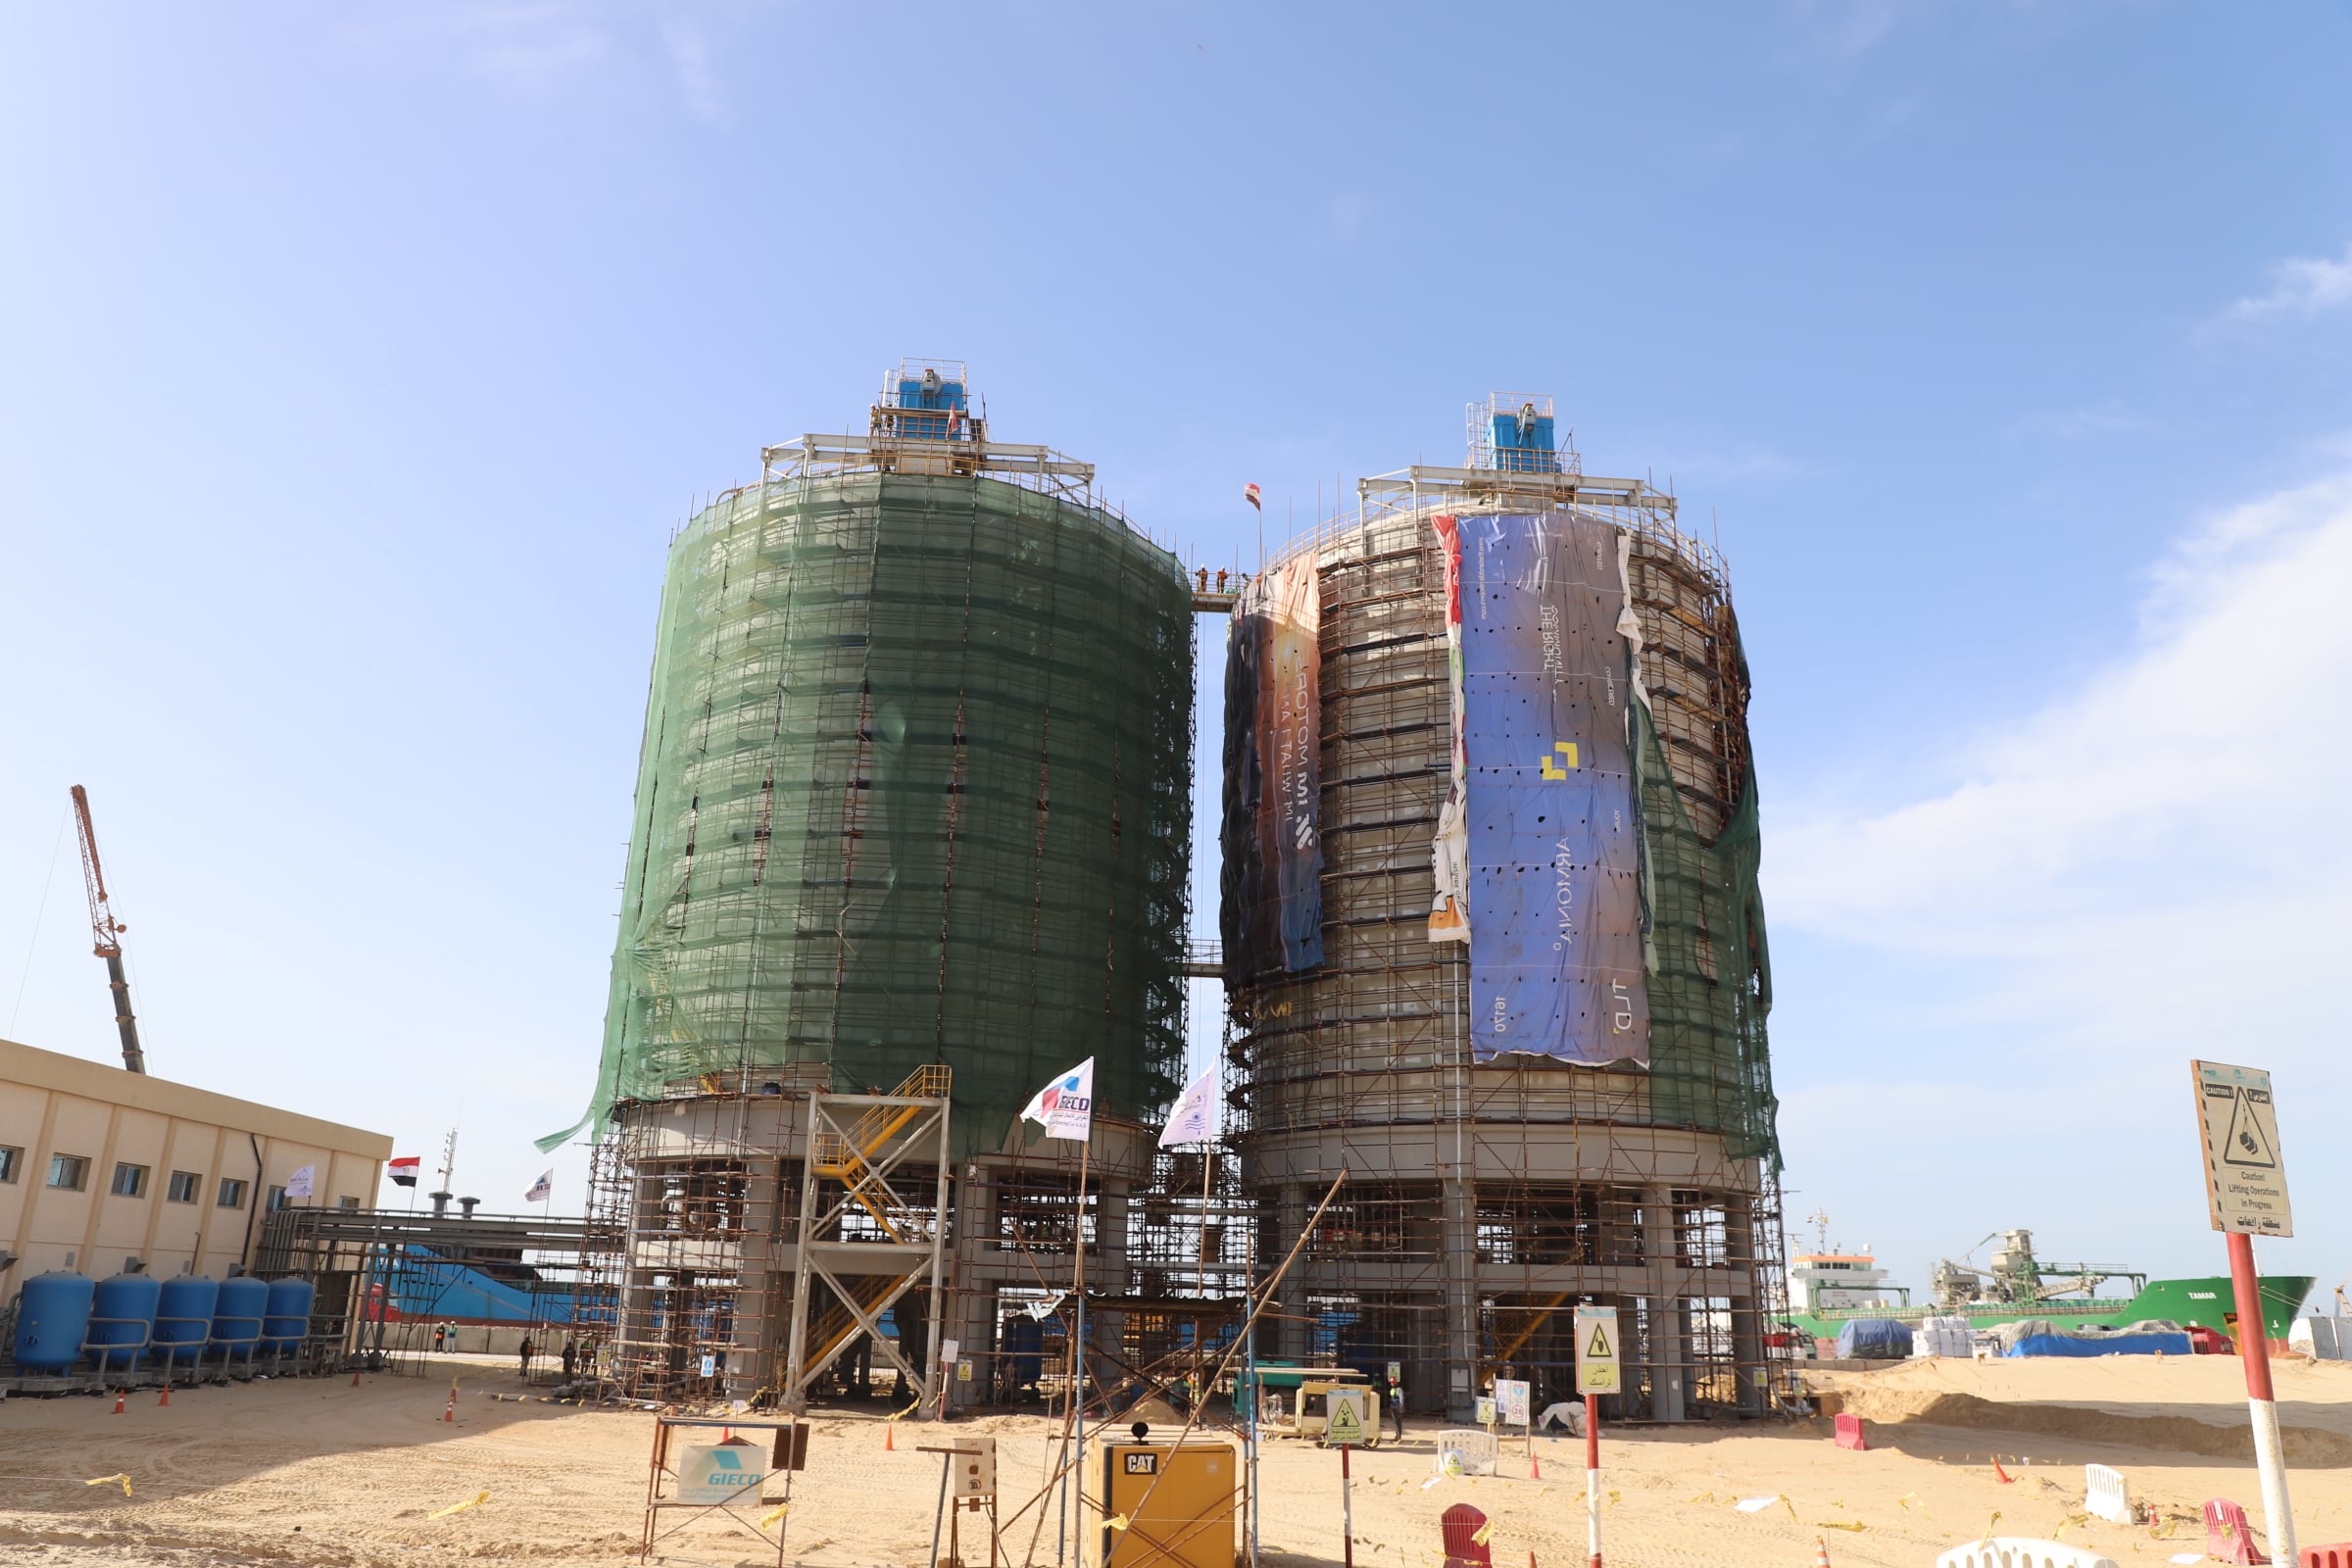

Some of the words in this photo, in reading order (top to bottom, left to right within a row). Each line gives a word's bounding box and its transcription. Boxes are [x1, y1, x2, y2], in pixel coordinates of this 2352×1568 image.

[2229, 1184, 2250, 1196] Lifting
[2250, 1186, 2279, 1197] Operations
[2248, 1199, 2273, 1210] Progress
[1127, 1454, 1154, 1473] CAT
[709, 1473, 761, 1485] GIECO
